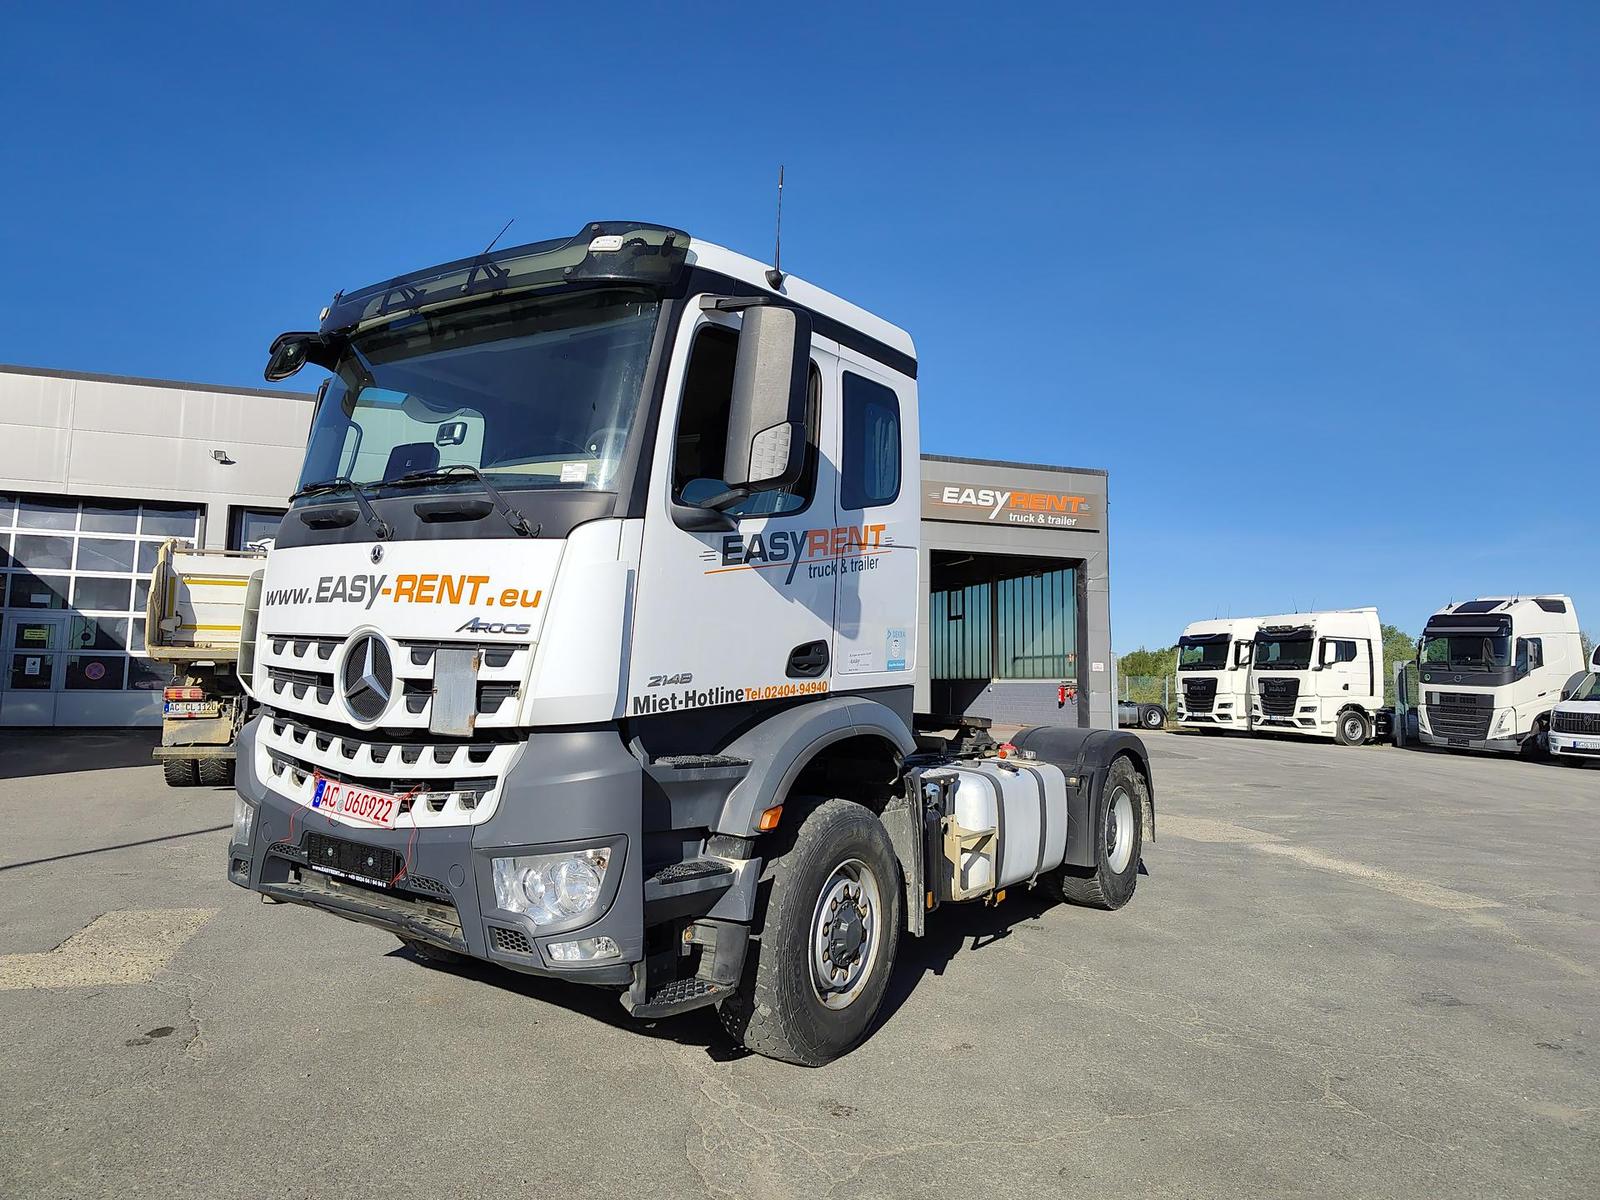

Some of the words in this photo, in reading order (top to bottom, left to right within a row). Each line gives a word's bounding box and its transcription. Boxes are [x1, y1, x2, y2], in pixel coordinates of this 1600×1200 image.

[1009, 512, 1034, 524] truck
[1037, 514, 1045, 524] &
[1047, 516, 1077, 526] trailer
[808, 563, 837, 579] truck
[840, 561, 848, 574] &
[850, 557, 879, 572] trailer
[266, 574, 542, 609] www.EASY-RENT.eu
[647, 672, 693, 688] 2148
[170, 703, 180, 711] AC
[185, 703, 196, 711] CL
[633, 686, 744, 715] Miet-Hotline
[321, 785, 339, 808] AC
[344, 790, 393, 822] 060922
